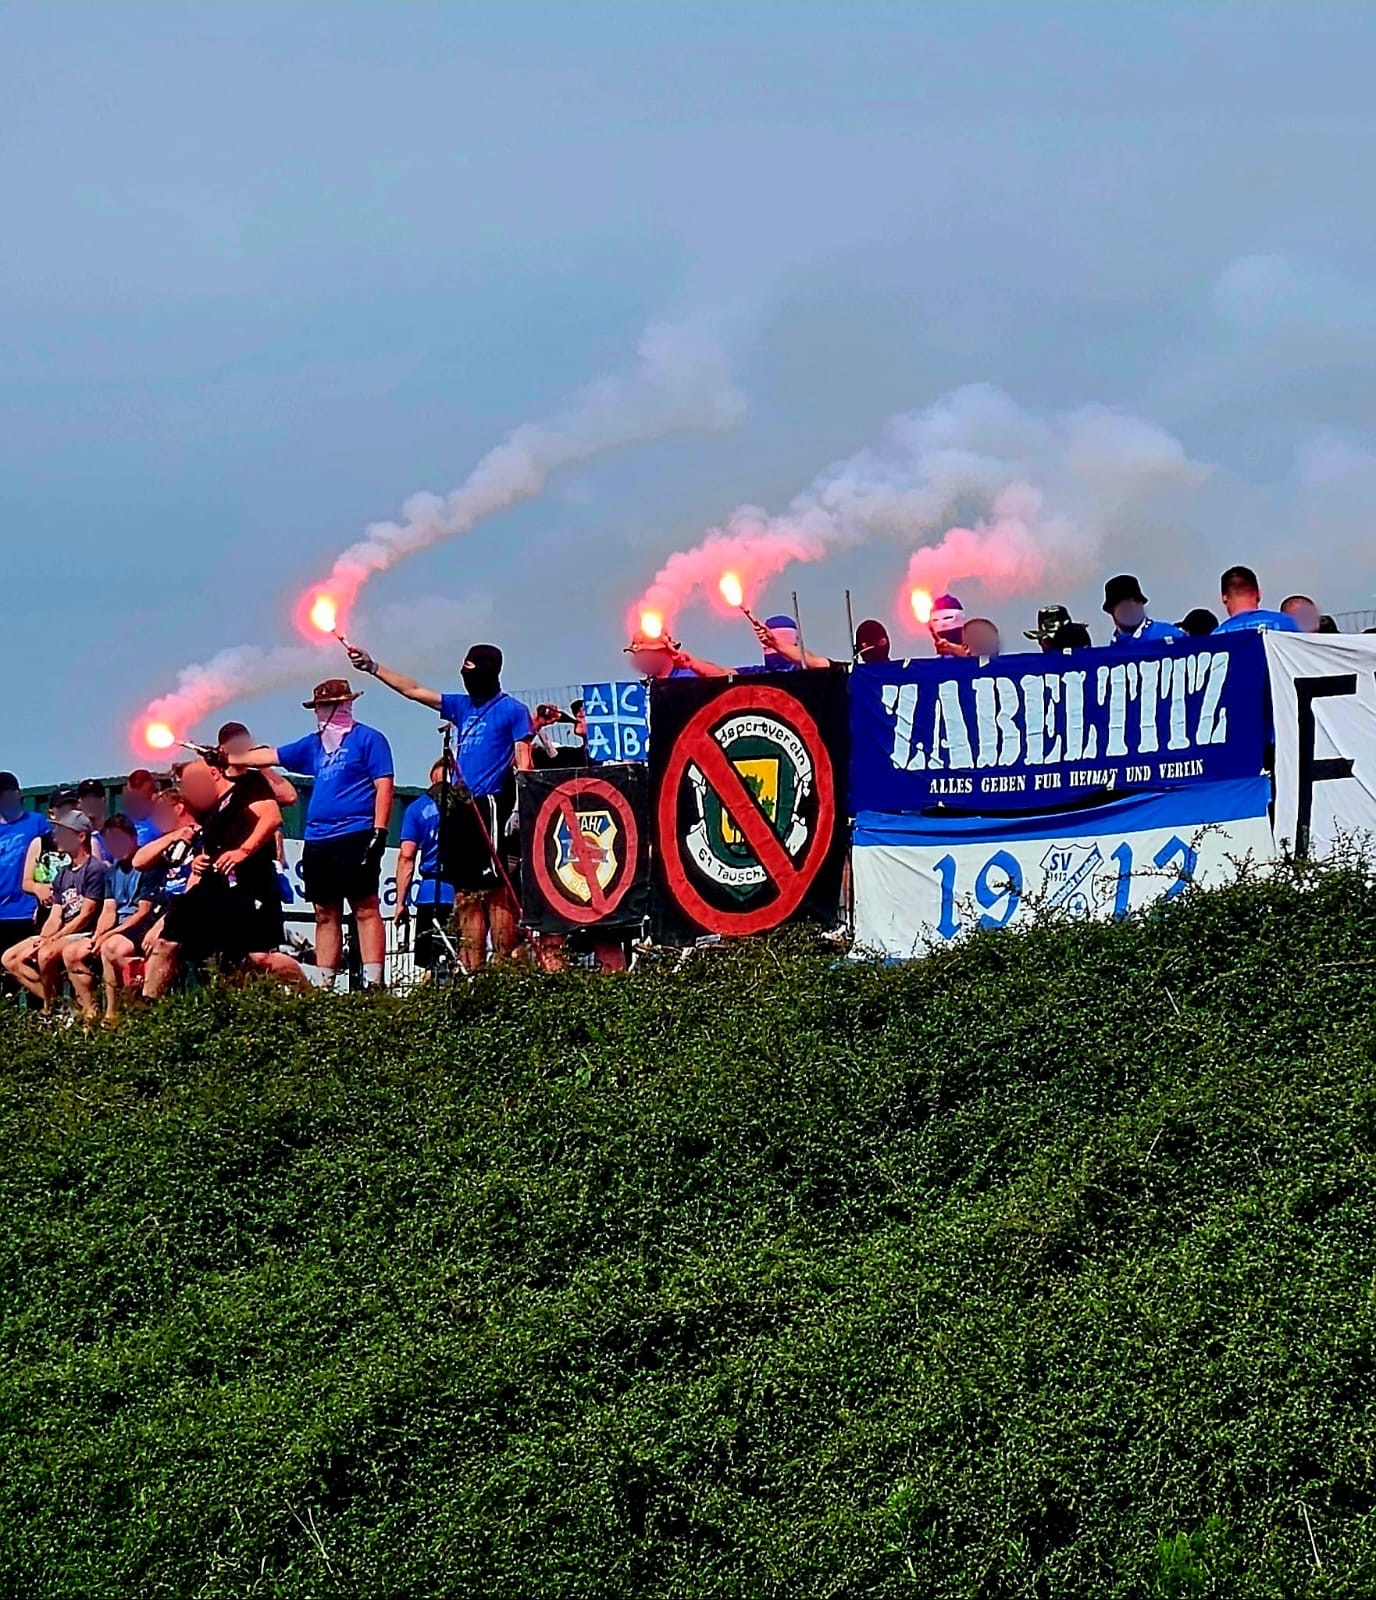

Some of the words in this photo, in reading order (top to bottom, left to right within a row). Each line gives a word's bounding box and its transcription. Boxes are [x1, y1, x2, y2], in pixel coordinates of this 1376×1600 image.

[881, 652, 1230, 770] ZABELTITZ
[929, 777, 973, 794] ALLES
[981, 775, 1026, 793] GEBEN
[1069, 768, 1118, 788] HEIMAT
[1126, 765, 1152, 783] UND
[1158, 758, 1205, 779] VEREIN
[717, 864, 768, 883] Tausch
[1049, 852, 1073, 872] SV
